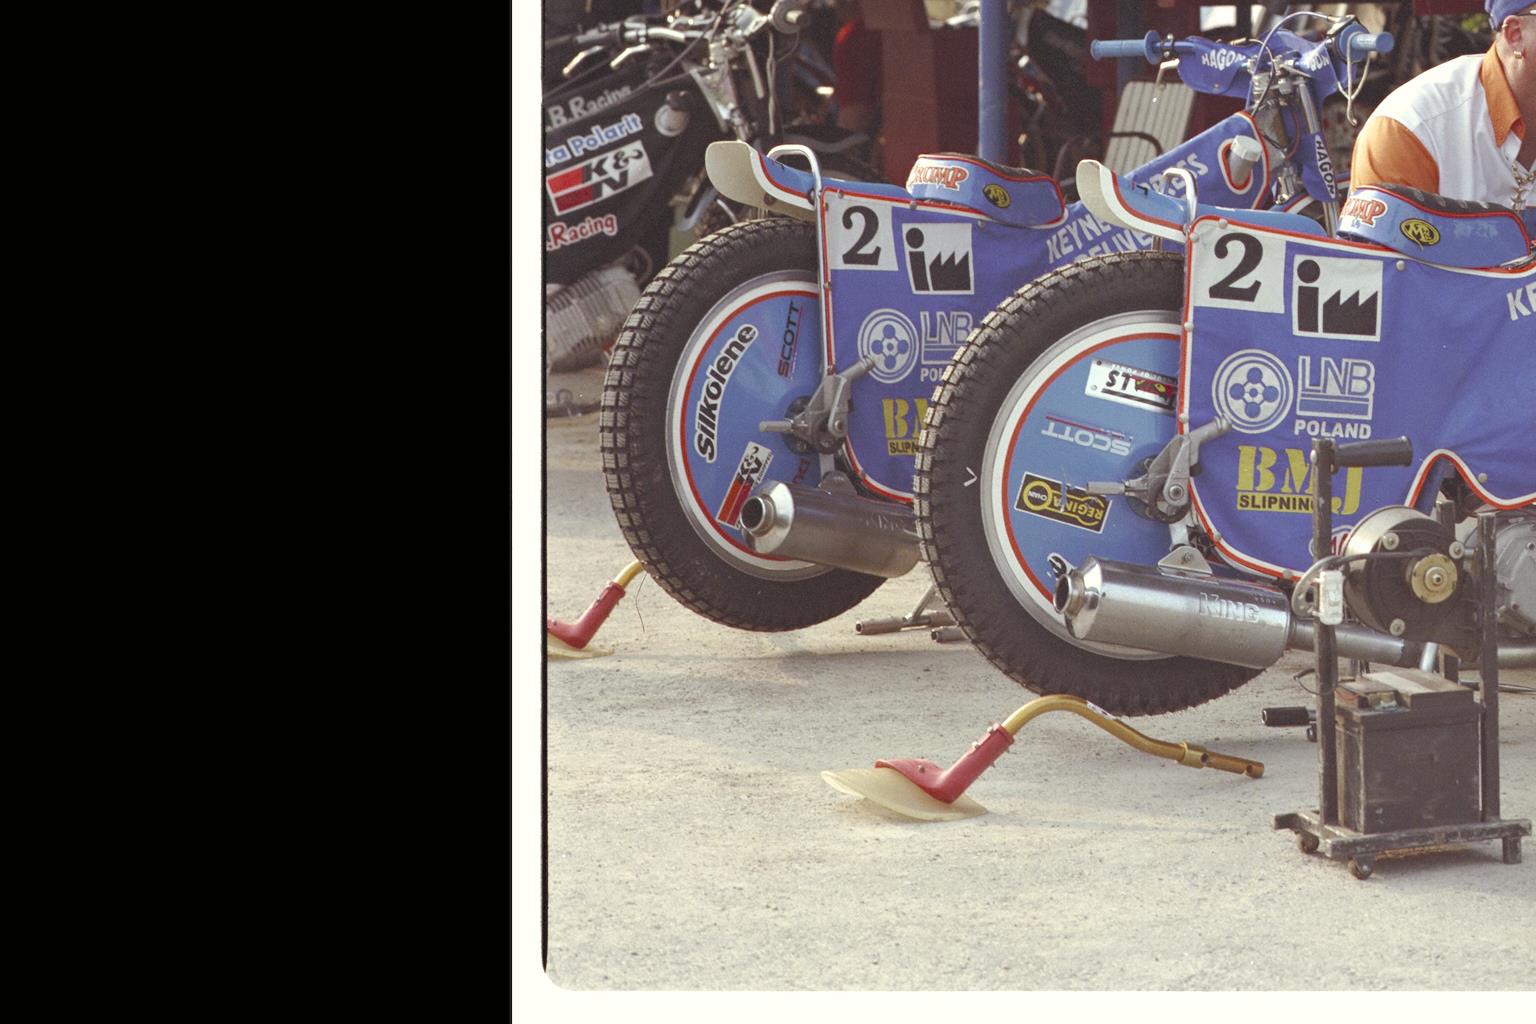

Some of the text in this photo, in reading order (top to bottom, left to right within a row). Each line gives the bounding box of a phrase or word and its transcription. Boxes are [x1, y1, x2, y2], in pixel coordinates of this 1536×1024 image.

[569, 117, 643, 157] Polarit
[1315, 139, 1336, 200] HAGON
[842, 206, 881, 266] 2
[1209, 232, 1264, 303] 2
[778, 301, 800, 378] SCOTT
[697, 325, 755, 462] Silkolene
[1297, 355, 1375, 397] LNB
[1041, 422, 1131, 456] SCOTT
[1294, 419, 1372, 439] POLAND
[1051, 496, 1106, 520] REGINA
